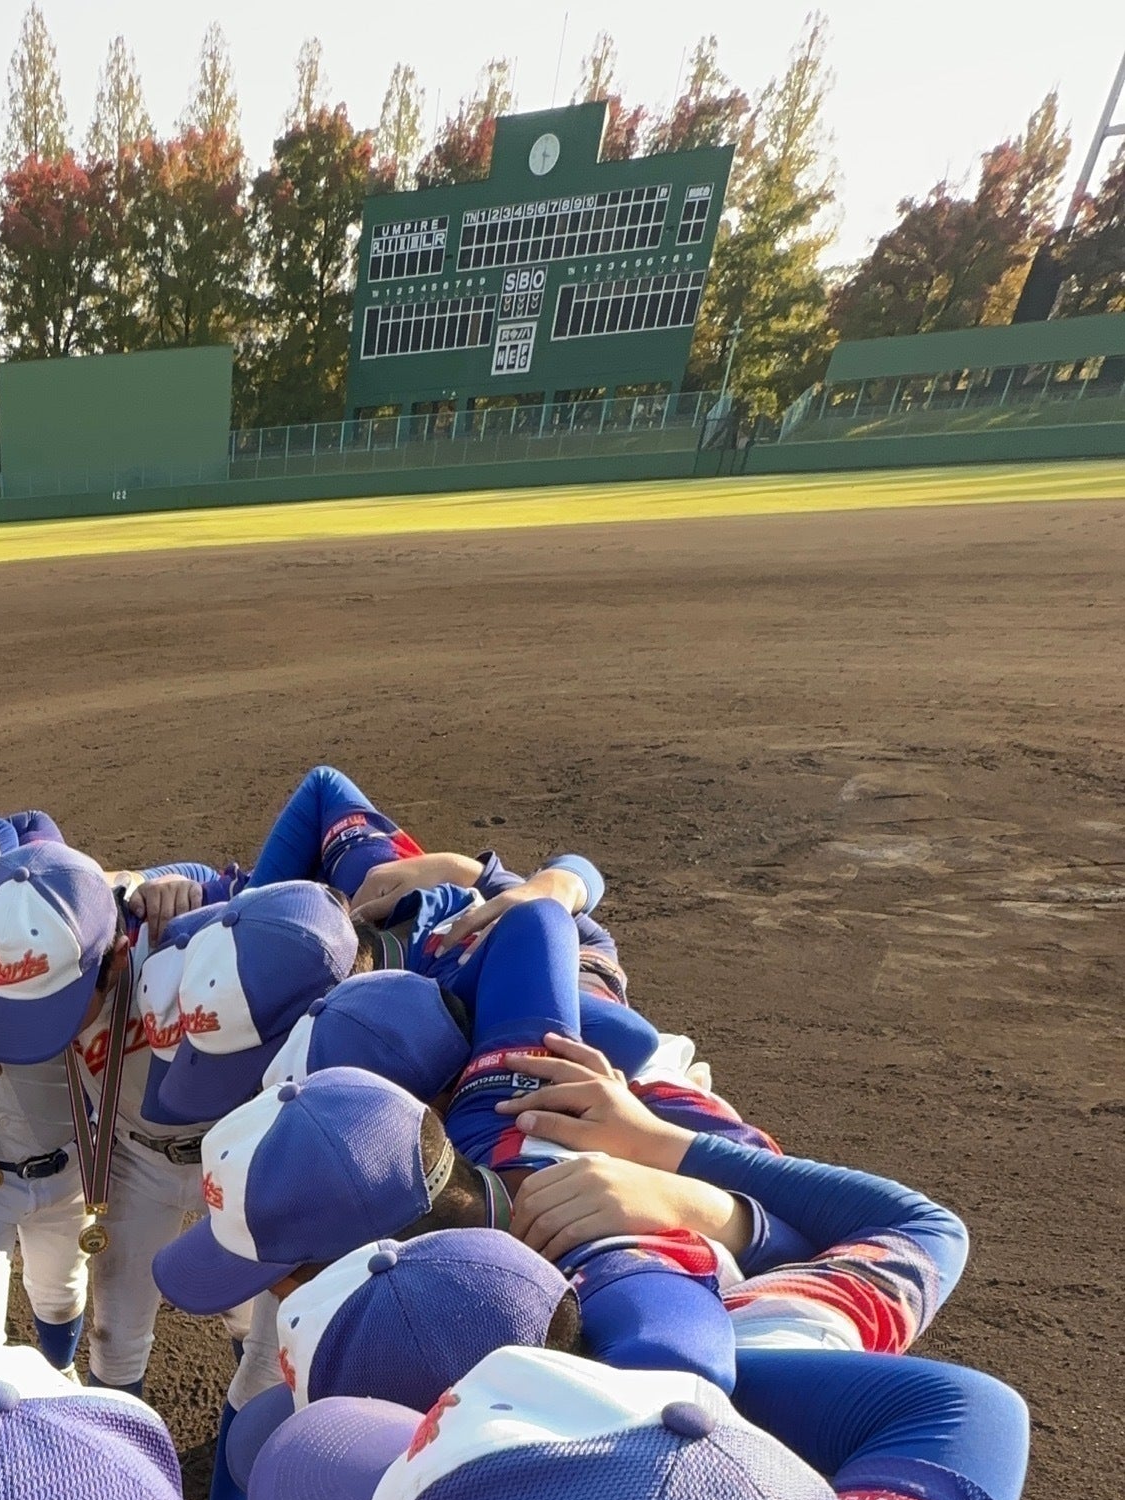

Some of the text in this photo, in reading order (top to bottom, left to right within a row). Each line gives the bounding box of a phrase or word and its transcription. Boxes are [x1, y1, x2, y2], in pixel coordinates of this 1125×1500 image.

[480, 212, 487, 221] 1
[491, 209, 500, 220] 2
[502, 208, 511, 219] 3
[513, 207, 523, 217] 4
[525, 204, 535, 215] 5
[537, 203, 546, 214] 6
[549, 201, 558, 212] 7
[561, 200, 570, 210] 8
[573, 198, 582, 209] 9
[585, 196, 595, 208] 10
[382, 219, 438, 236] UMPIRE
[422, 233, 431, 247] L
[434, 232, 445, 246] R
[505, 273, 516, 291] S
[518, 271, 530, 289] B
[112, 490, 127, 500] 122
